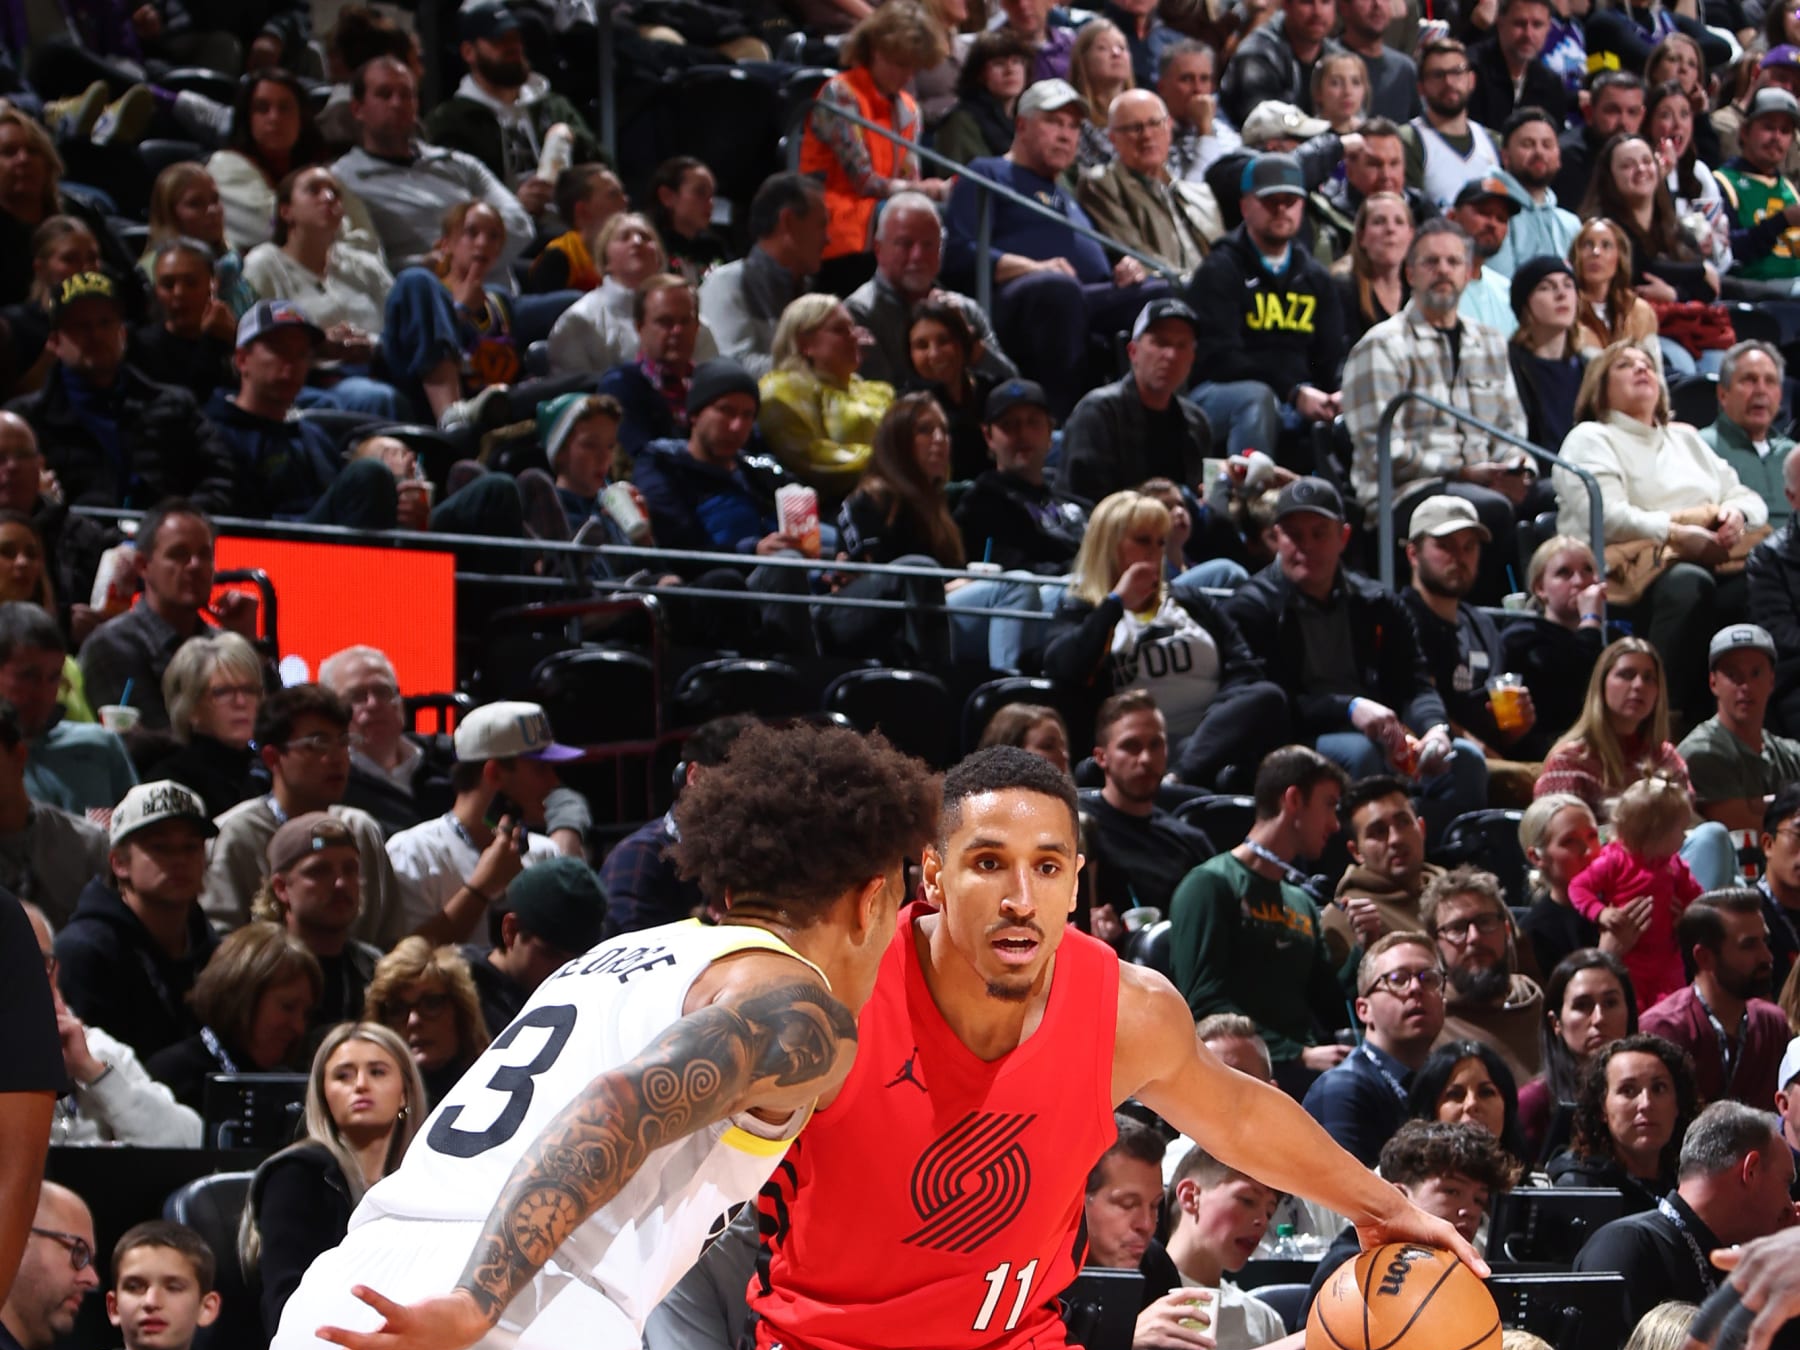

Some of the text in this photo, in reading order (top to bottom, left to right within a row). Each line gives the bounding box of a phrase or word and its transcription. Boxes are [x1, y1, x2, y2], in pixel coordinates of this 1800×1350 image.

[1245, 291, 1316, 333] JAZZ
[427, 1004, 577, 1158] 3
[972, 1258, 1040, 1332] 11
